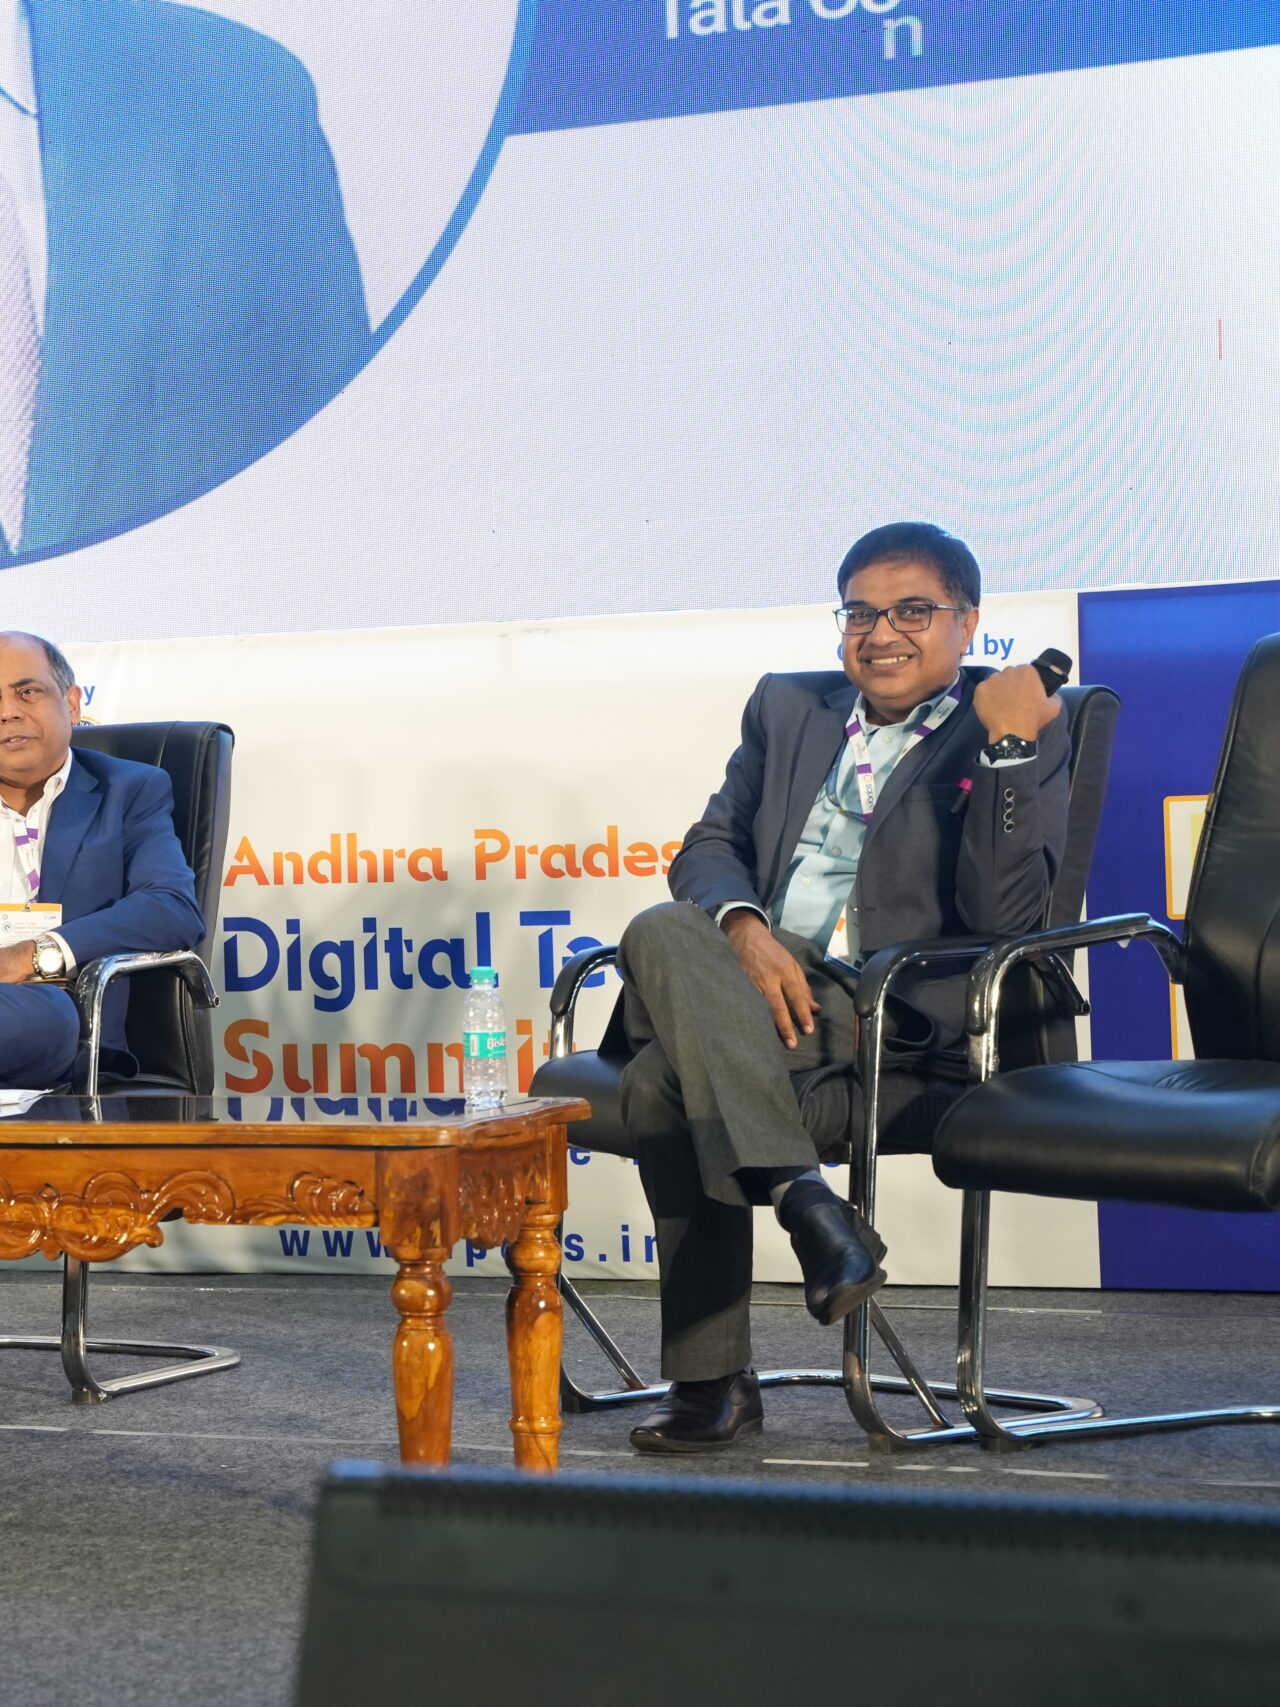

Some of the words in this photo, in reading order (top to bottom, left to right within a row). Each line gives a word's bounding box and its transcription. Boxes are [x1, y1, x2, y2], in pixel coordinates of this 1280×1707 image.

[983, 633, 1015, 660] by
[222, 832, 449, 887] Andhra
[474, 825, 684, 881] Prades
[222, 911, 499, 1013] Digital
